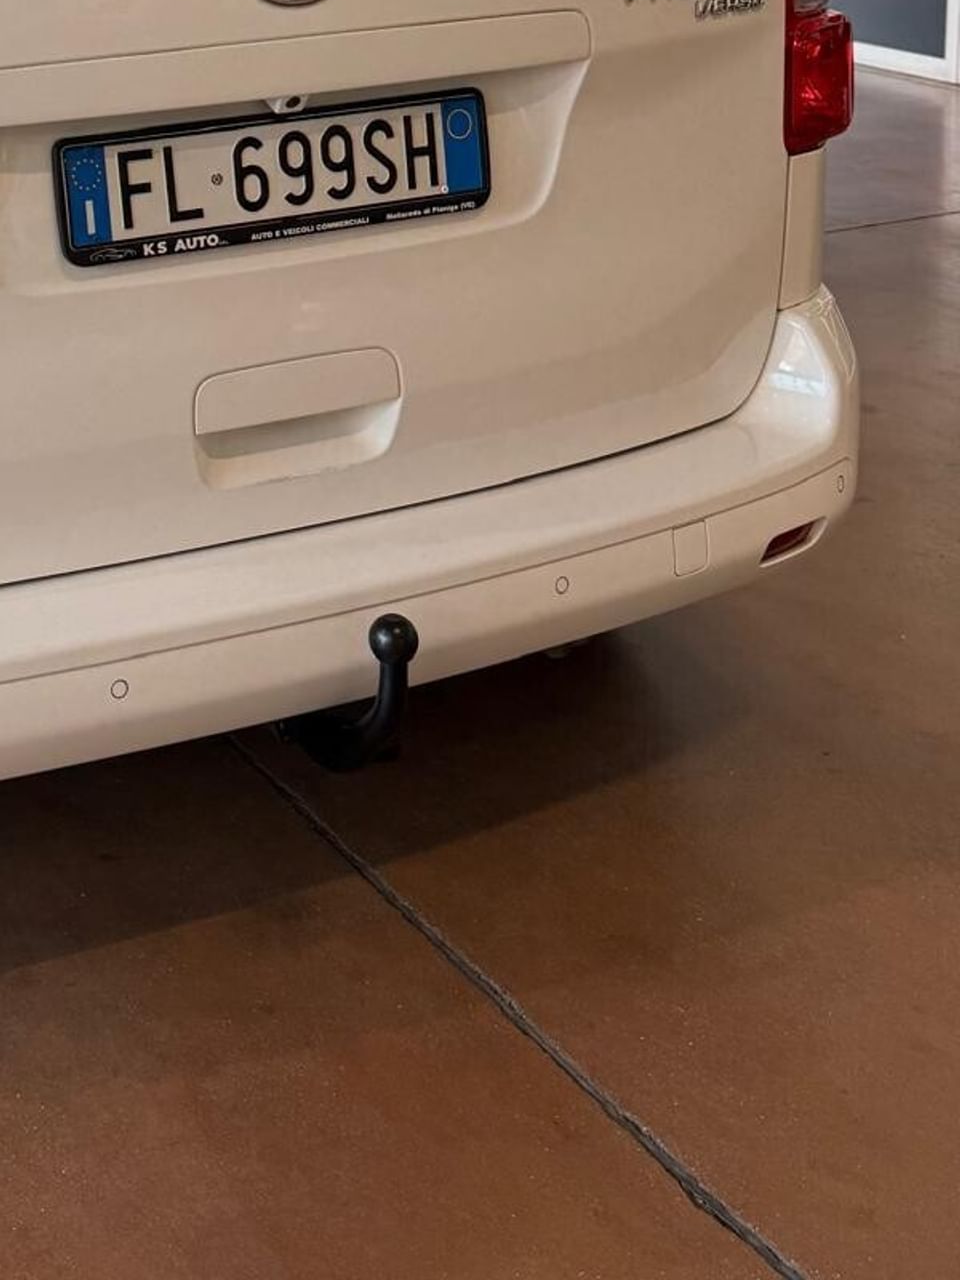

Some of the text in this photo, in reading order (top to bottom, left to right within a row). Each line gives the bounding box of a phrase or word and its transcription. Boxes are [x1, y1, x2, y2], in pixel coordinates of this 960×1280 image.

[116, 145, 205, 229] FL
[232, 111, 440, 212] 699SH
[251, 230, 273, 240] AUTO
[283, 225, 315, 236] VEICOLI
[316, 216, 370, 231] COMMERCIALI
[143, 241, 167, 256] KS
[174, 234, 220, 252] AUTO
